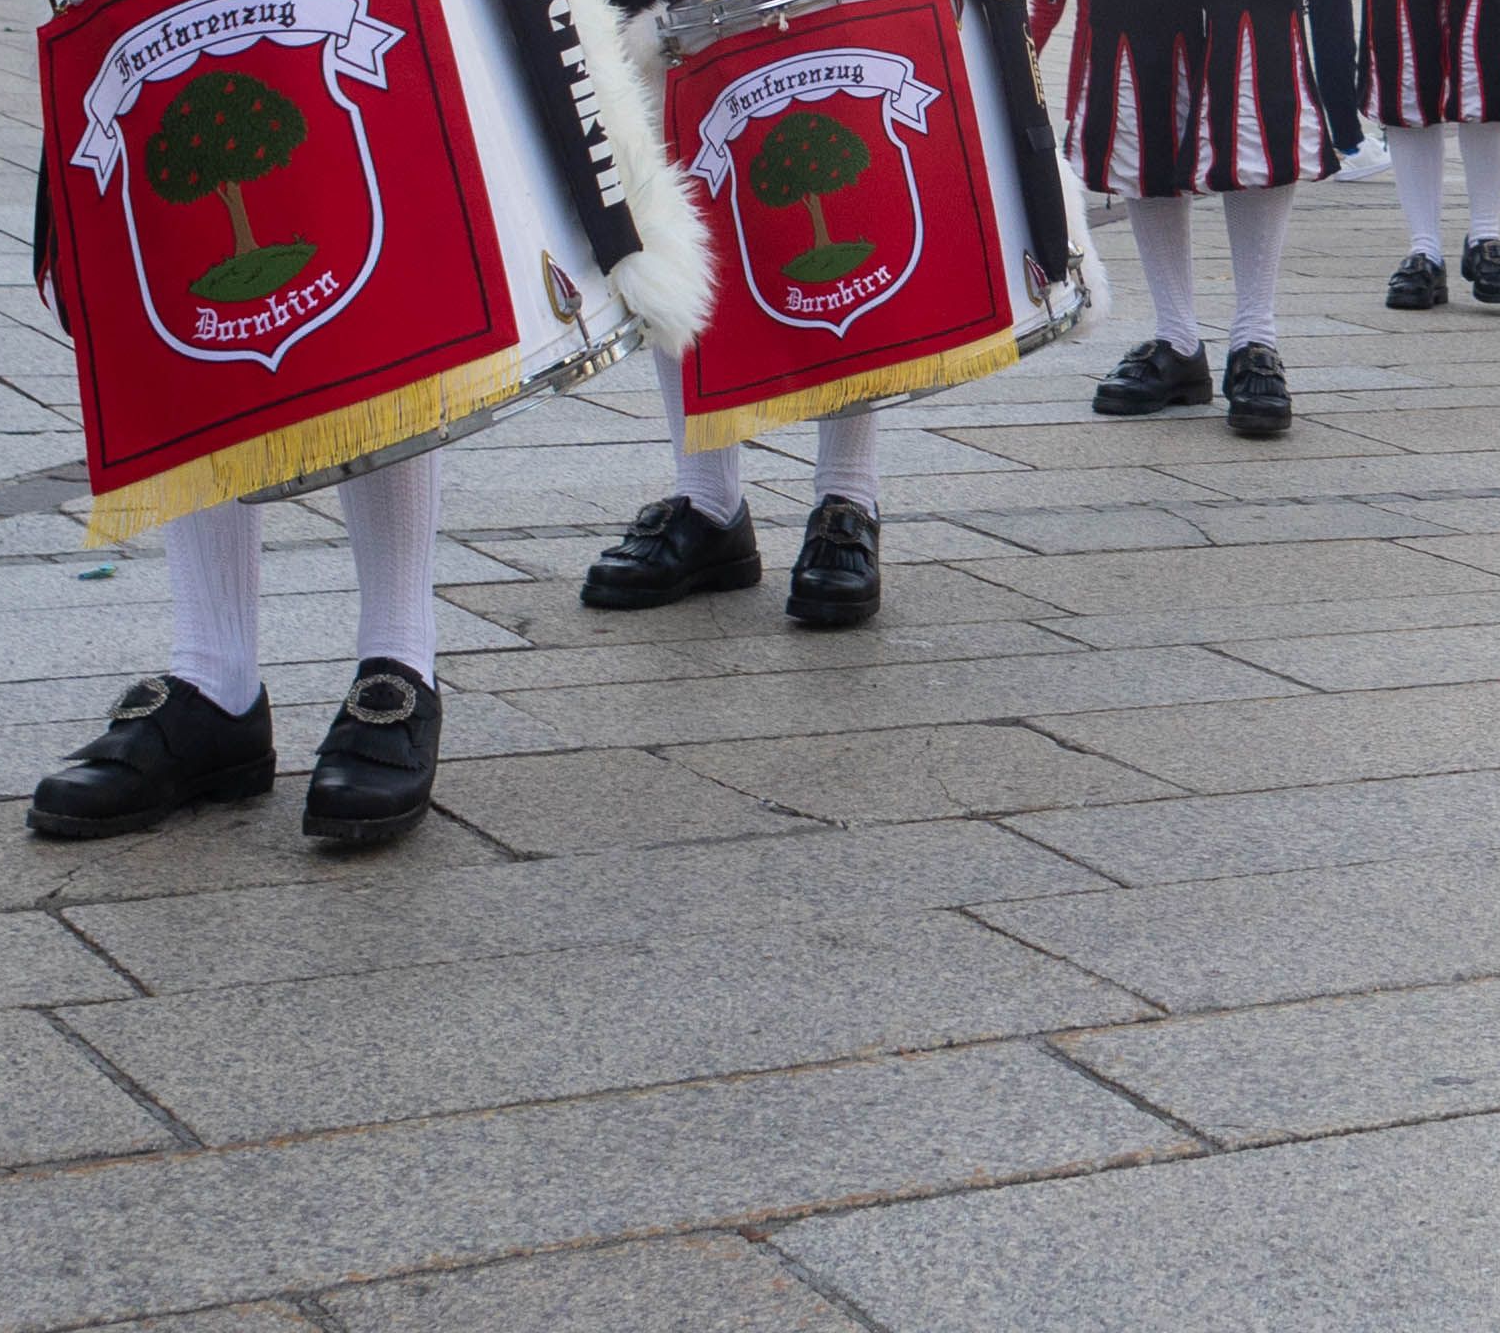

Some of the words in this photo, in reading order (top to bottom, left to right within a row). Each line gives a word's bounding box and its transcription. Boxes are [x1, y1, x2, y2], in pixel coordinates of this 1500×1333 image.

[114, 0, 297, 85] Fanfarenzug
[725, 63, 865, 119] Fanfarenzug
[191, 269, 340, 342] Dornbirn
[784, 264, 893, 313] Dornbirn
